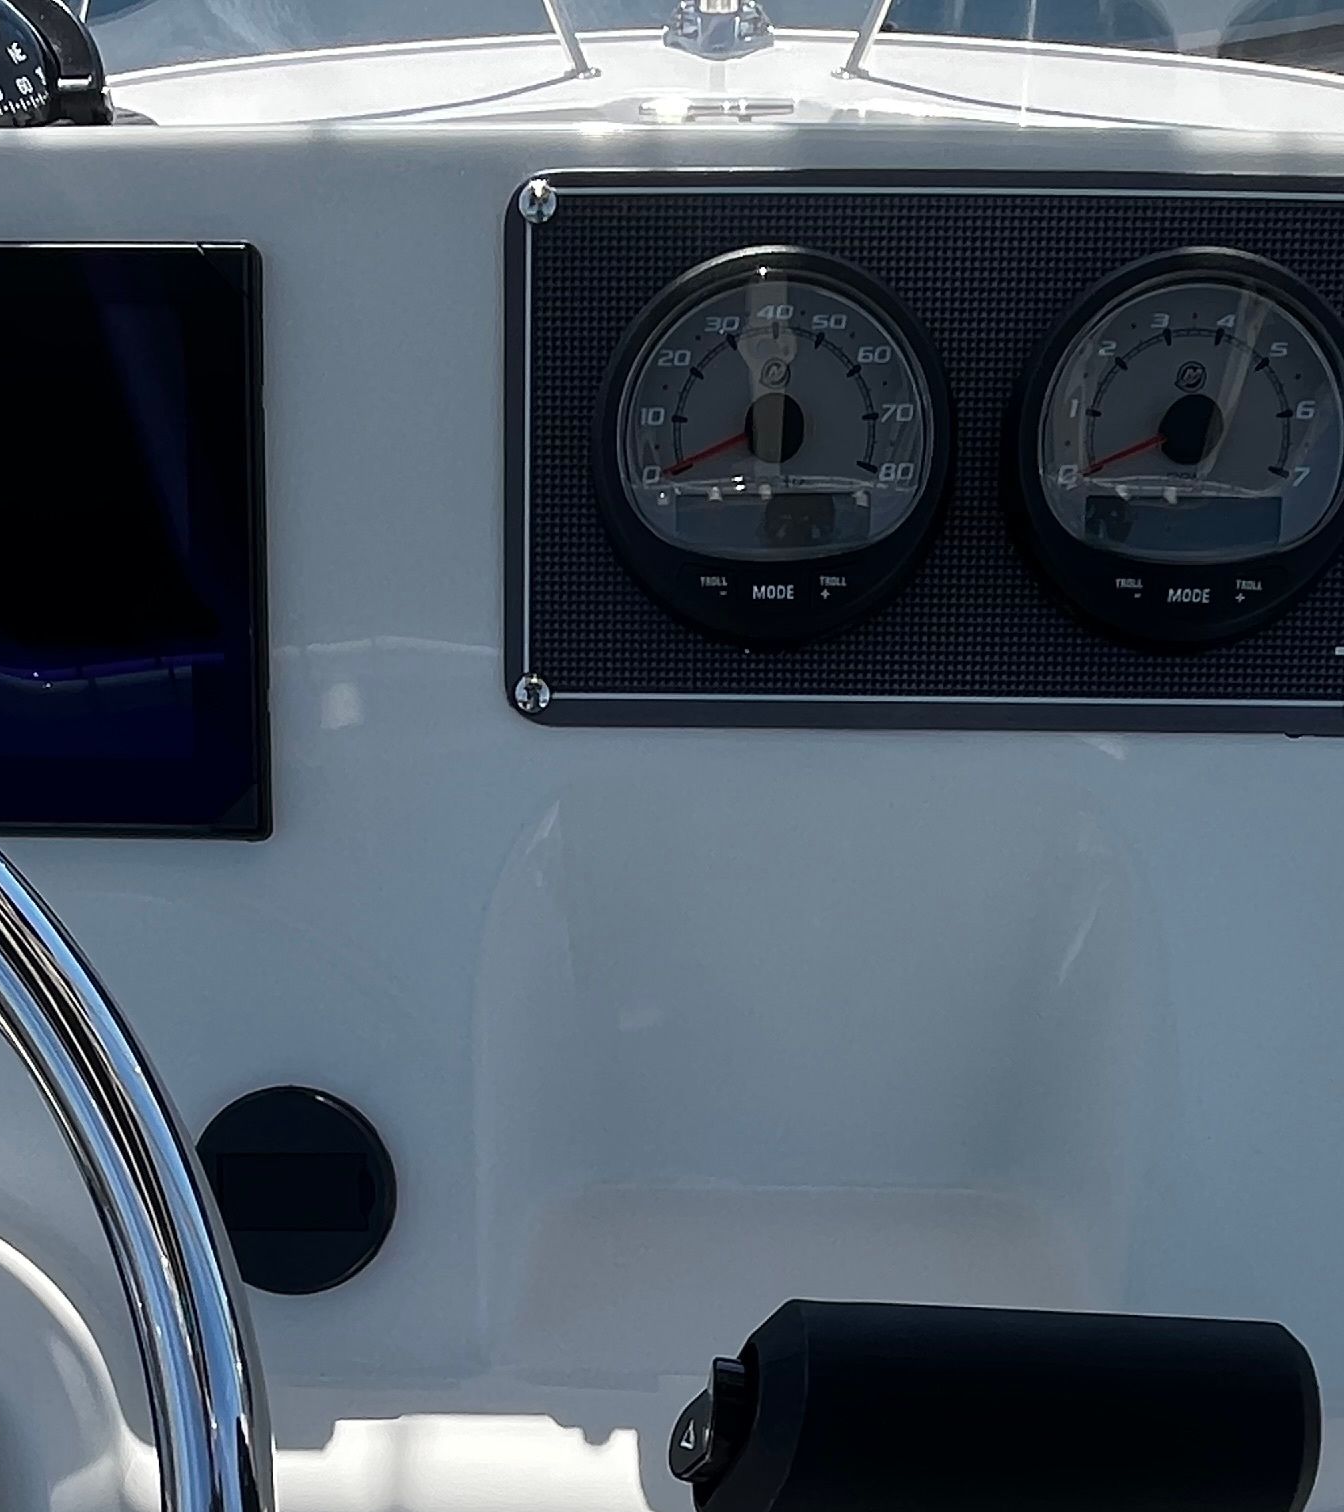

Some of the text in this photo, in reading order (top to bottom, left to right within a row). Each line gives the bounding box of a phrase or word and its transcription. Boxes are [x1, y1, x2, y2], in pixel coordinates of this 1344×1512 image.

[16, 76, 34, 96] 60
[757, 304, 795, 321] 40
[1150, 313, 1170, 329] 3
[1216, 313, 1236, 328] 4
[704, 316, 740, 333] 30
[812, 314, 847, 330] 50
[658, 349, 691, 366] 20
[857, 346, 892, 364] 60
[1098, 341, 1117, 357] 2
[1269, 342, 1289, 357] 5
[640, 407, 665, 426] 10
[881, 404, 914, 422] 70
[1069, 399, 1080, 418] 1
[1295, 400, 1316, 419] 6
[643, 466, 661, 485] 0
[878, 463, 915, 482] 80
[1292, 467, 1312, 487] 7
[752, 585, 795, 600] MODE
[1167, 588, 1210, 604] MODE
